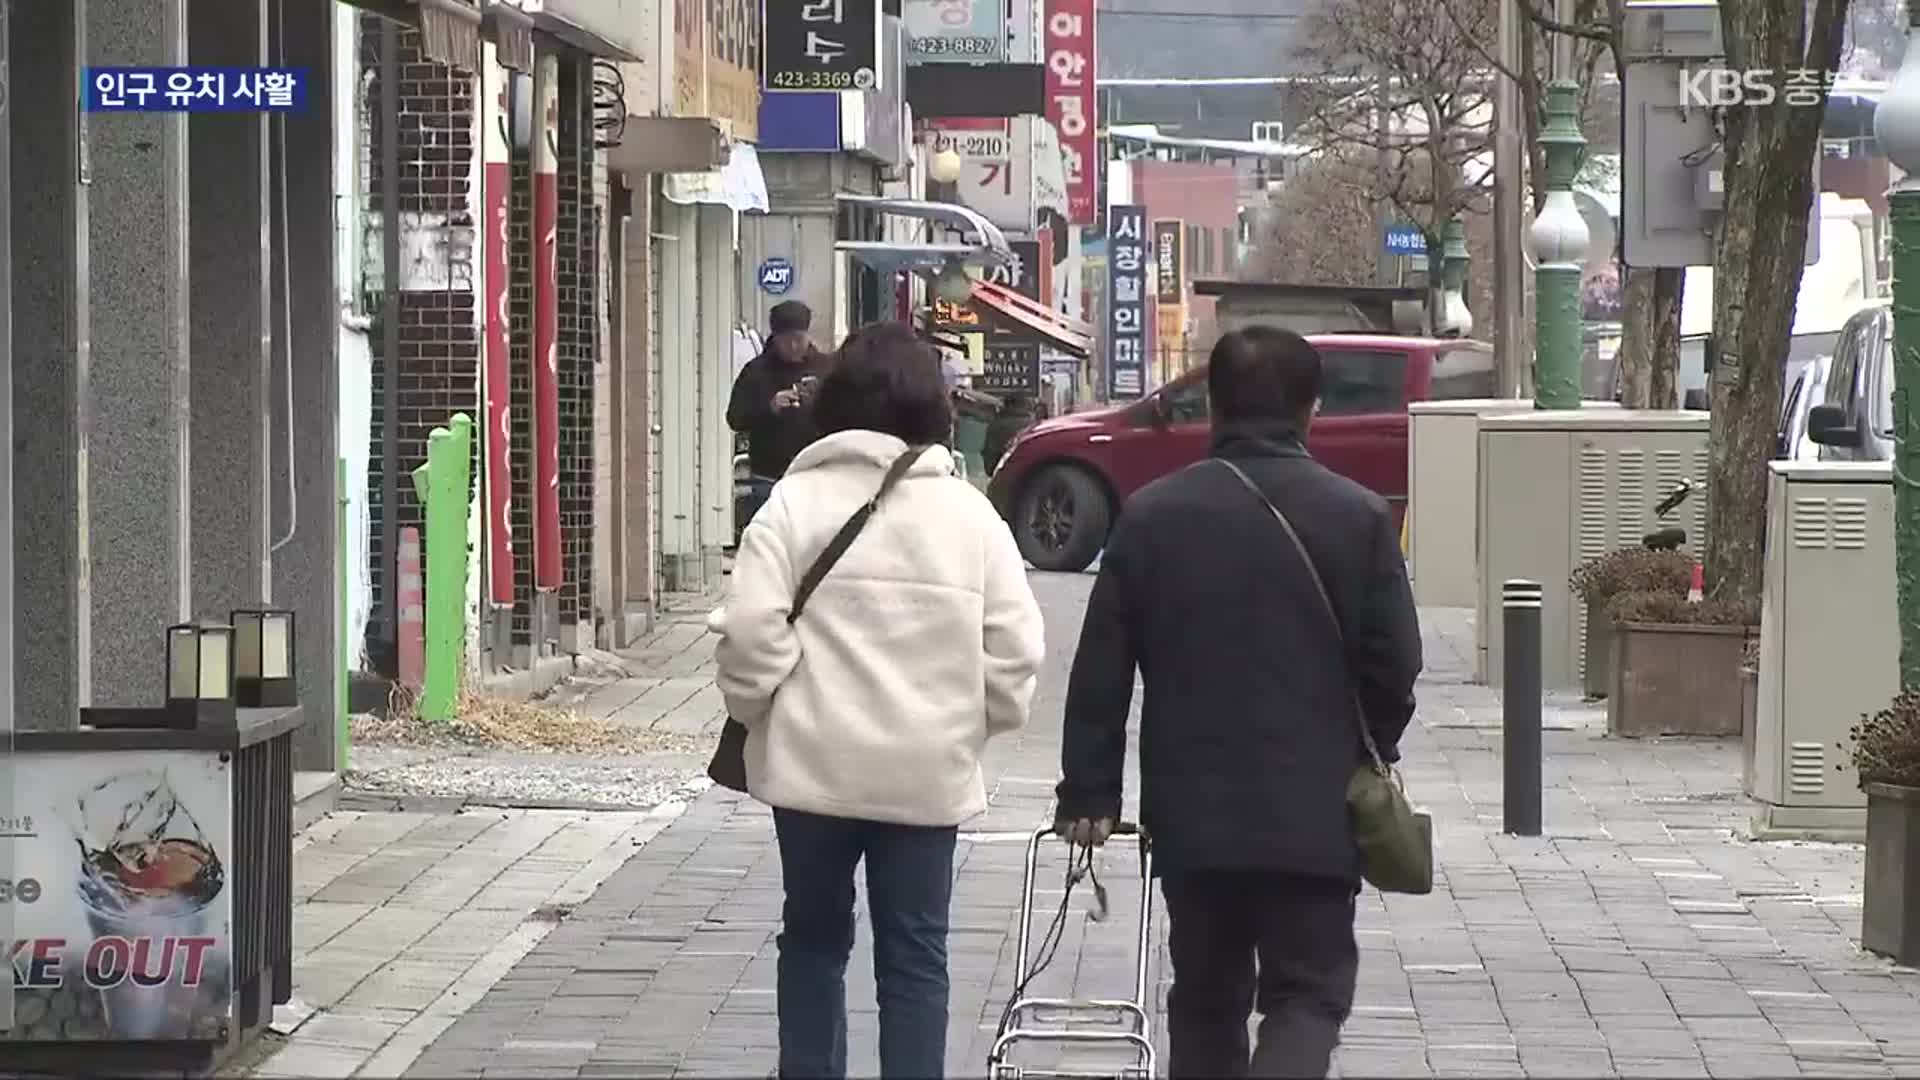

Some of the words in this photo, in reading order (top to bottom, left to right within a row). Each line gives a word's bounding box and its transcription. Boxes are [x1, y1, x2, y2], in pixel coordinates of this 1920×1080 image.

[774, 71, 851, 87] 423-3369
[978, 163, 1011, 196] 기
[762, 268, 790, 283] ADT
[1114, 214, 1143, 394] 시장할인마트
[83, 934, 216, 989] OUT
